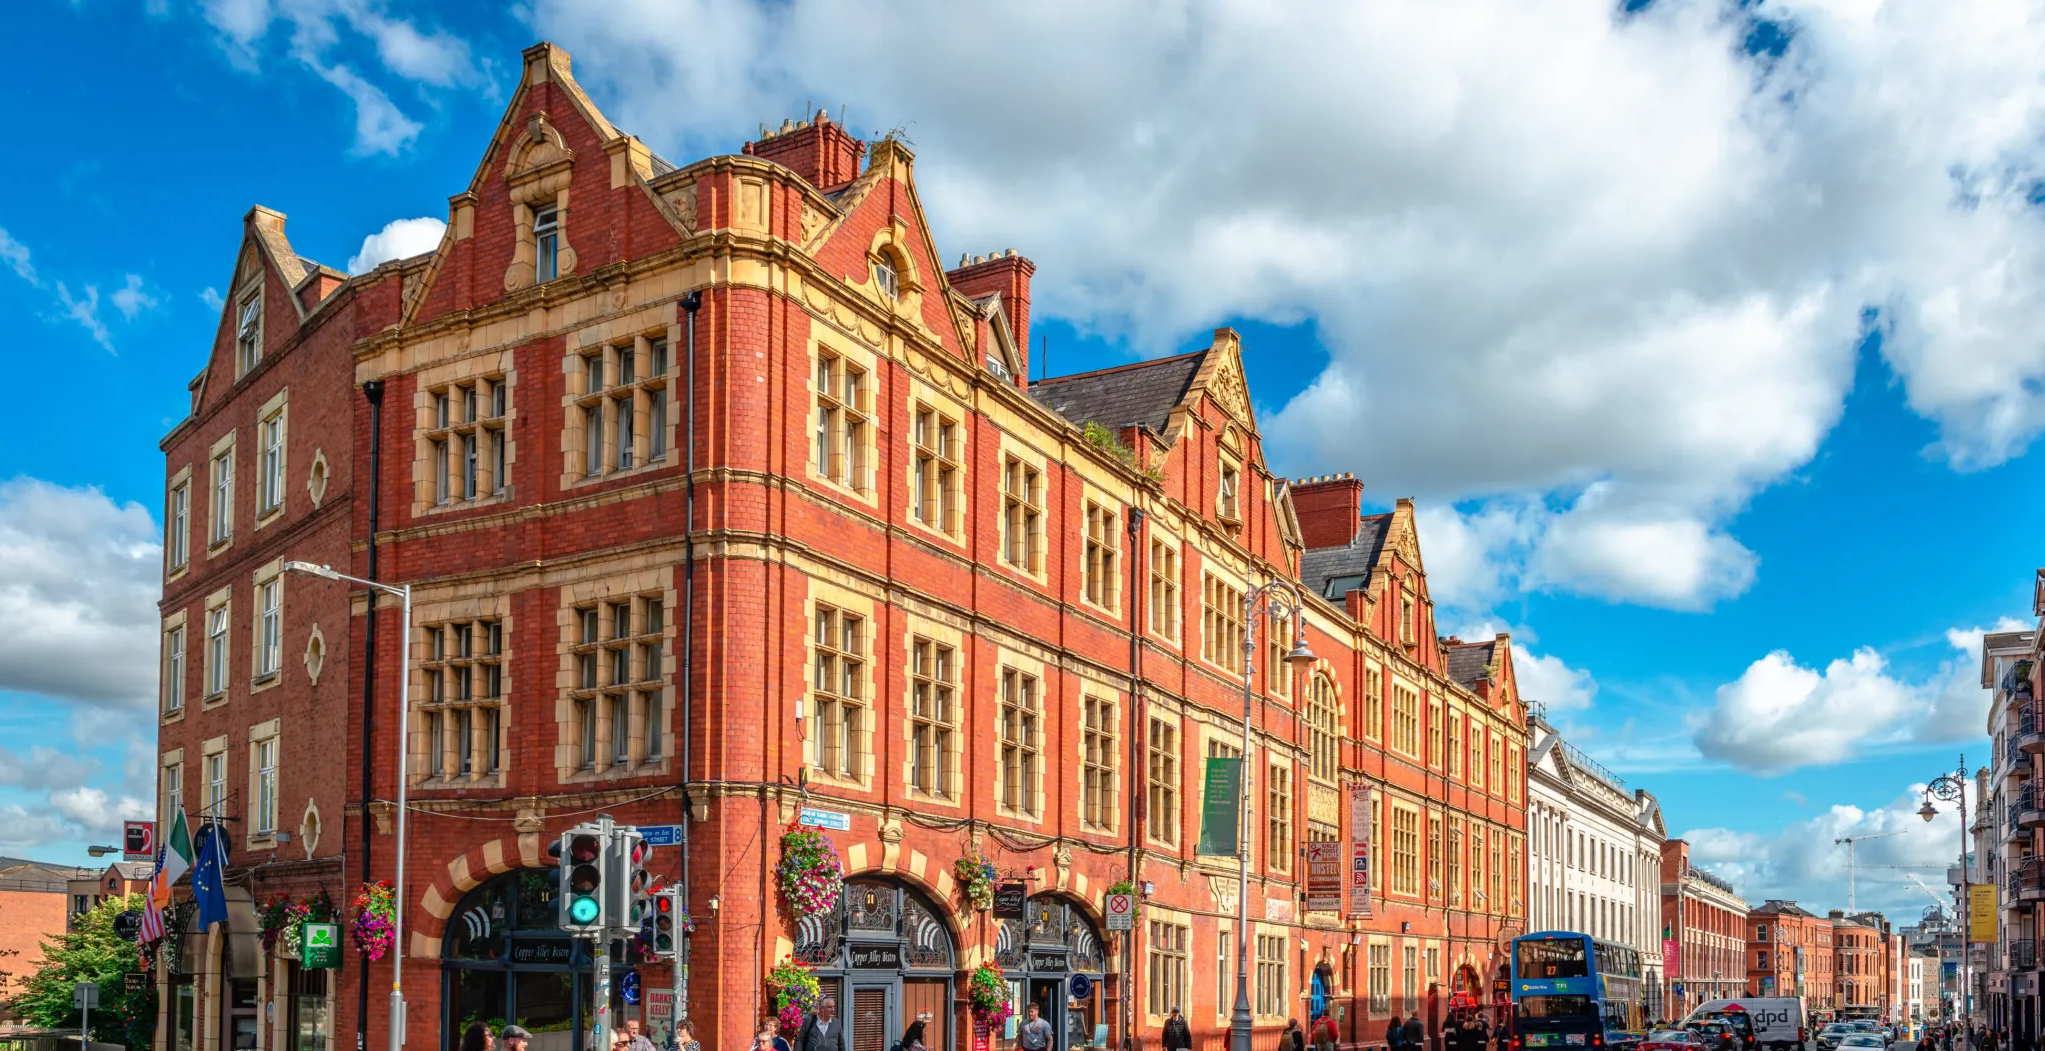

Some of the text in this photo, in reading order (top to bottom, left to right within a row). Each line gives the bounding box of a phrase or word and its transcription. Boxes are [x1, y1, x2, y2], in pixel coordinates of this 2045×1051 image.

[675, 829, 681, 842] 8
[1312, 864, 1336, 874] HOSTEL
[867, 894, 875, 904] 11
[514, 945, 535, 961] Copper
[851, 949, 896, 966] Copper Alley Bistro
[1033, 955, 1064, 970] Copper Alley Bistro
[1547, 966, 1556, 975] 27
[649, 993, 673, 1003] DARKE
[649, 1004, 670, 1015] KELLY
[1755, 1009, 1788, 1026] dpd
